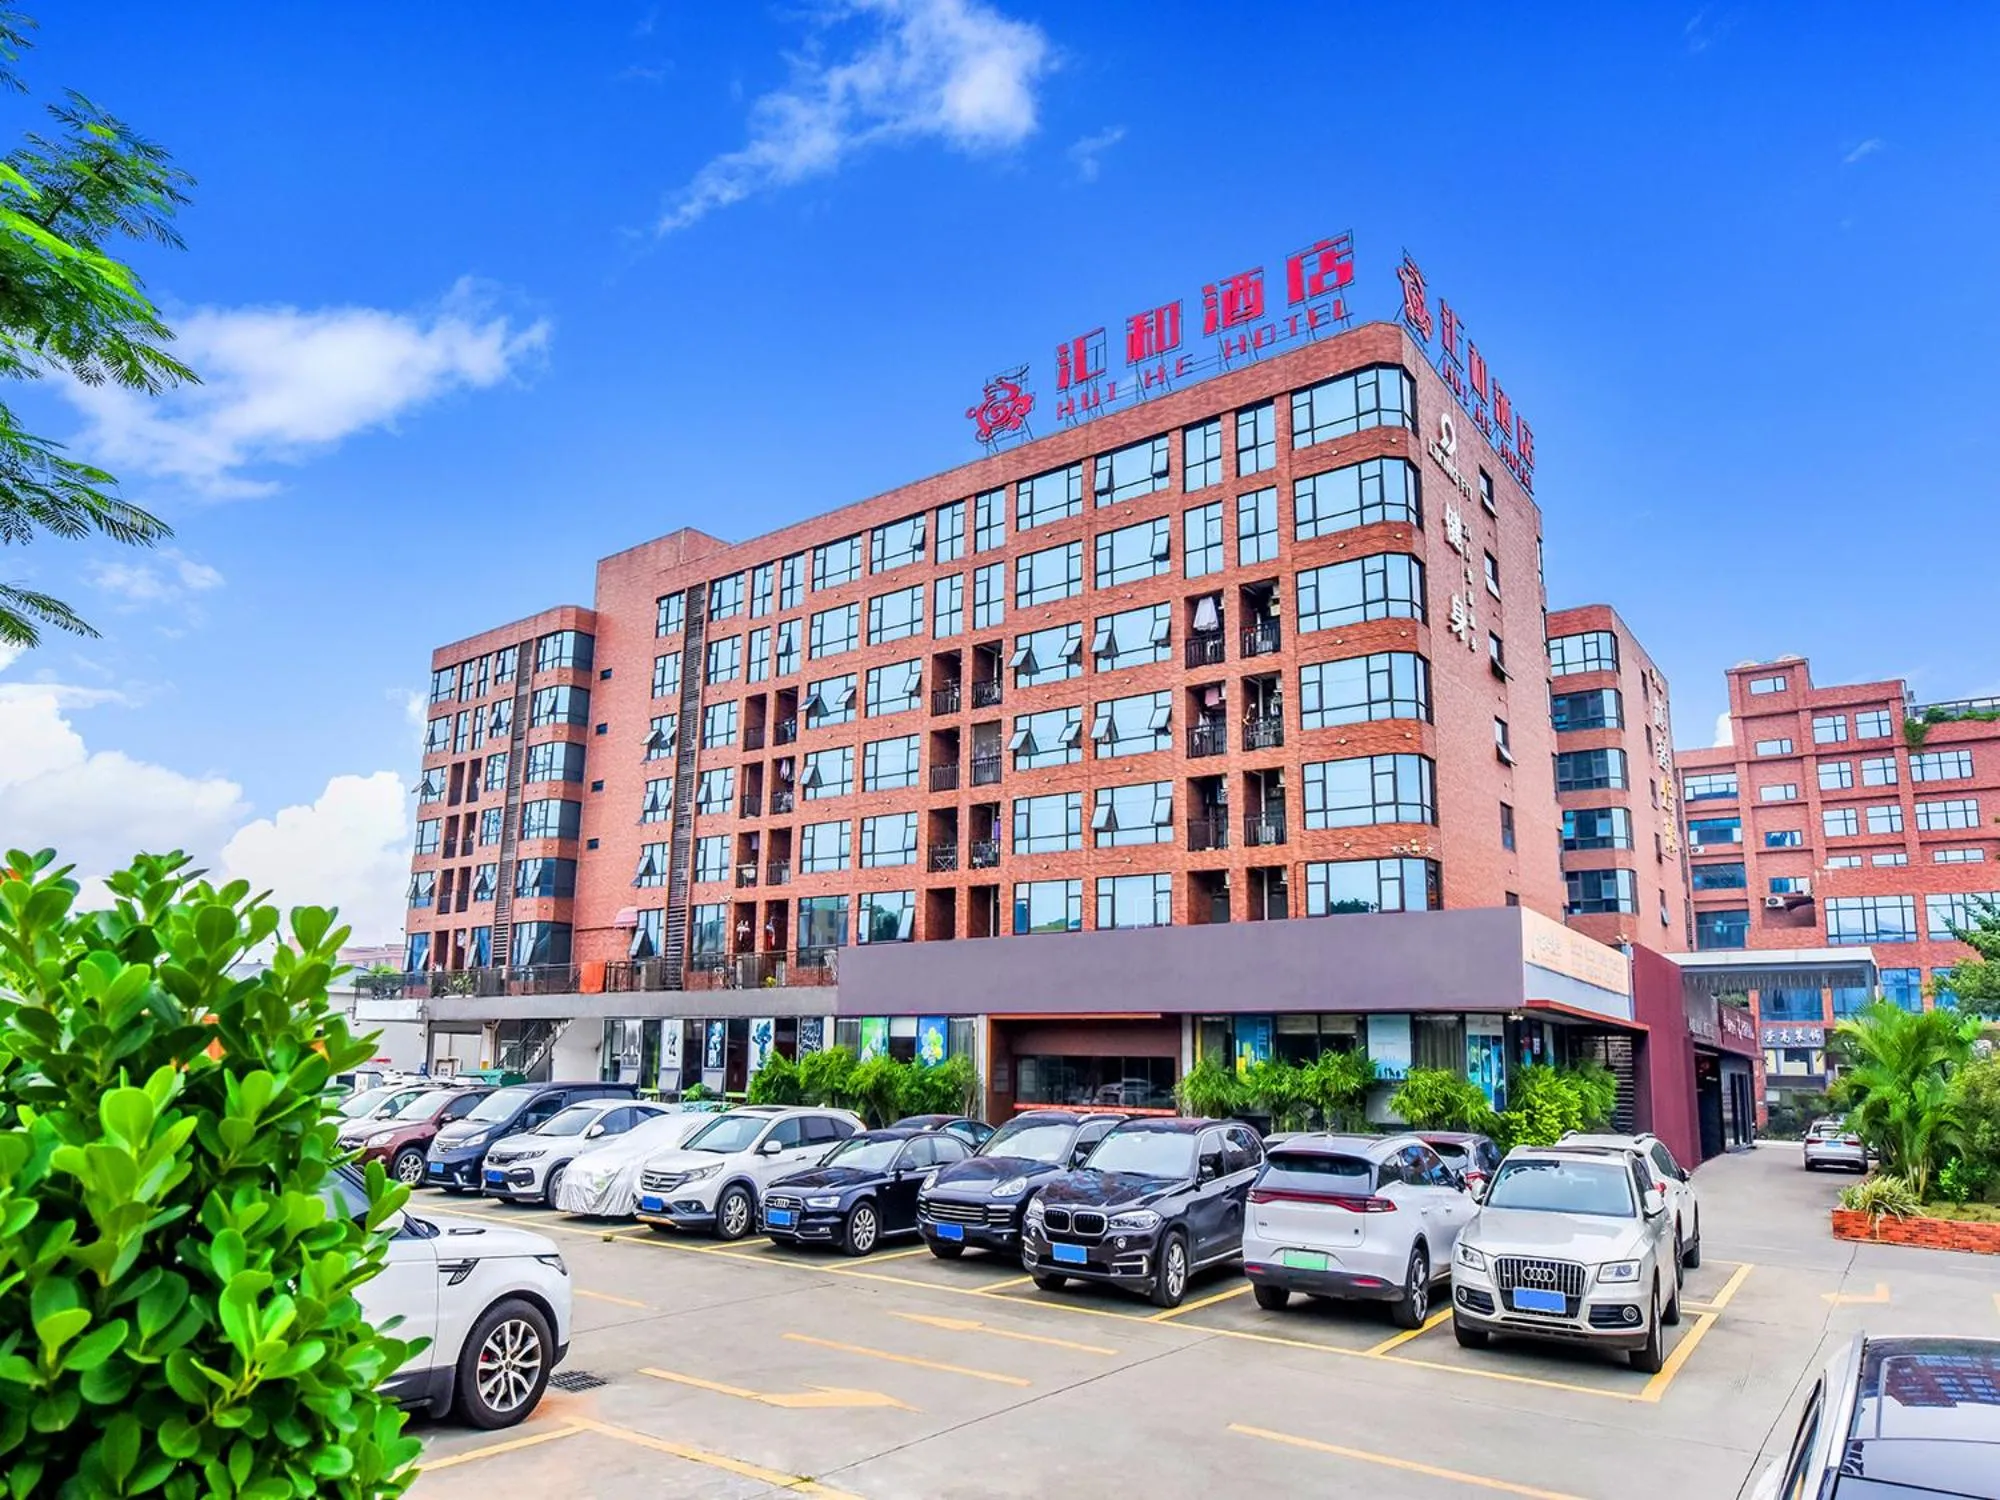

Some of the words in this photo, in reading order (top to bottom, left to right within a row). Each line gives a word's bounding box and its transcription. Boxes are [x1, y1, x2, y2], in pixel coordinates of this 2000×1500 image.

[1056, 235, 1353, 391] 汇和酒店
[1056, 382, 1117, 420] HUI
[1145, 353, 1194, 389] HE
[1224, 298, 1354, 360] HOTEL
